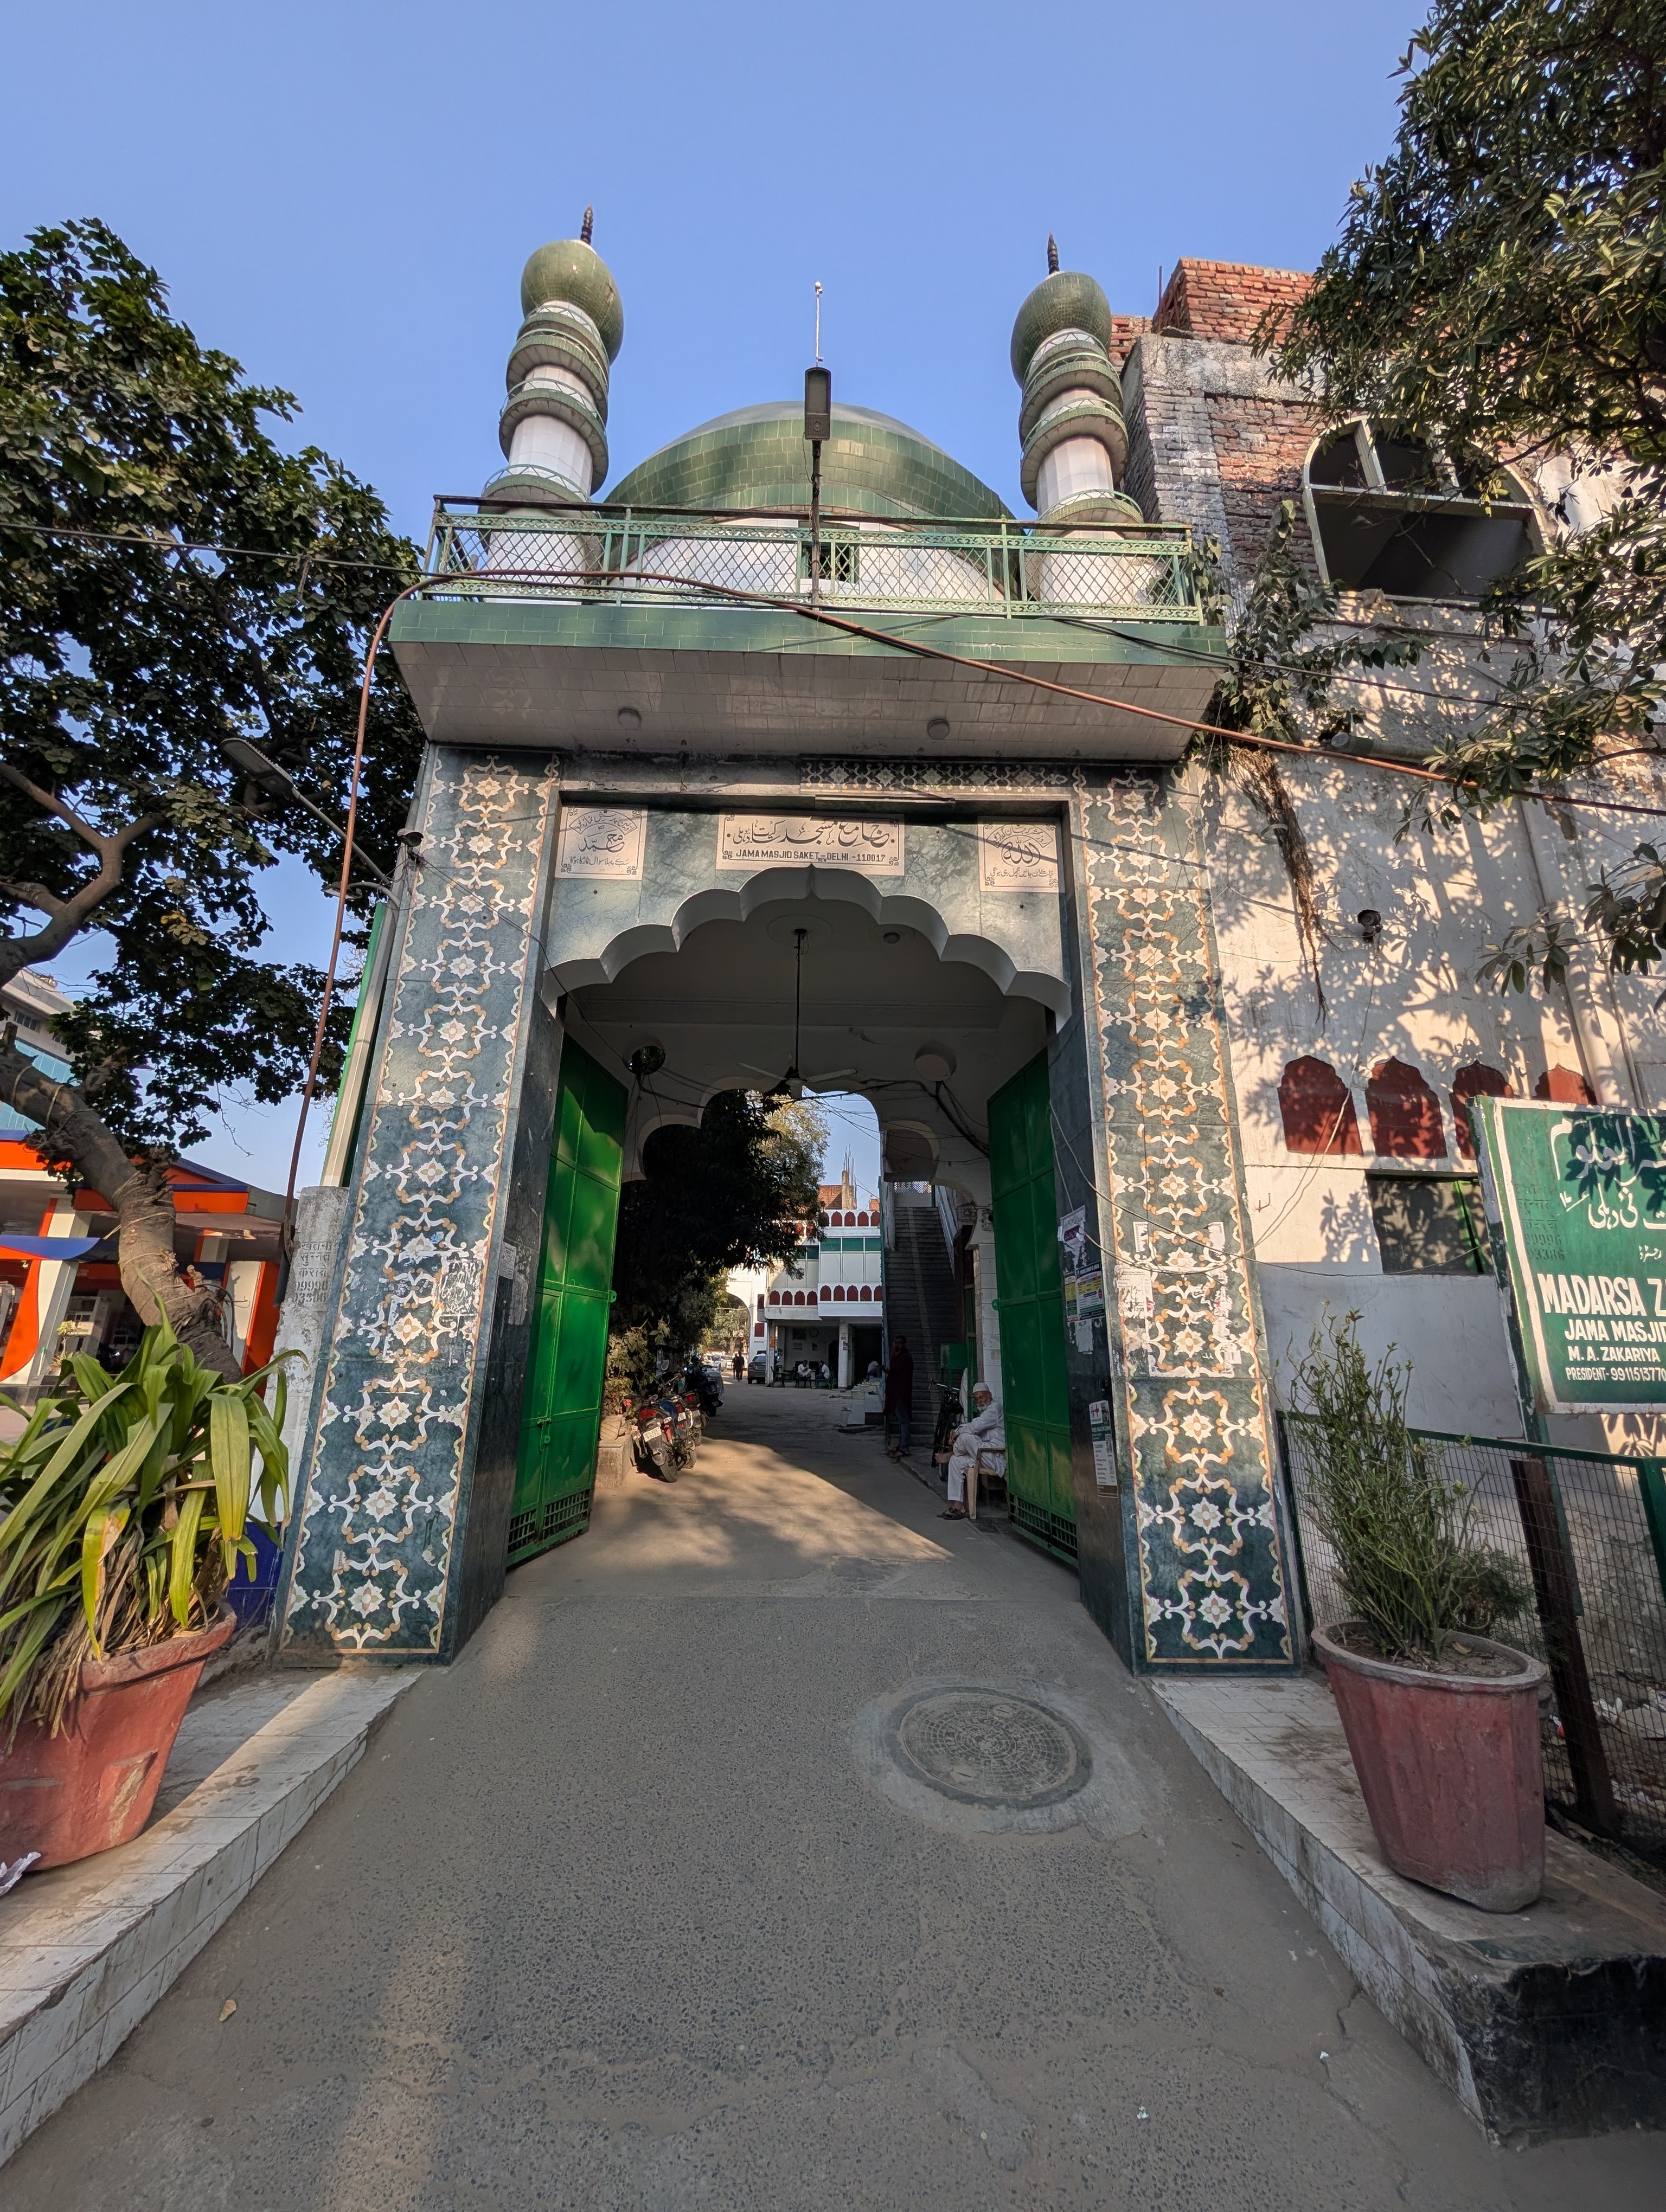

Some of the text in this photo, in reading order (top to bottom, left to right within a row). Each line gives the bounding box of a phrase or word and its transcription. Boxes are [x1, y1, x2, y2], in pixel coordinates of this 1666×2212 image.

[777, 819, 838, 845] مسجد
[838, 820, 890, 848] جامع
[736, 849, 760, 858] JAMA
[761, 850, 792, 859] MASJID
[793, 851, 819, 860] SAKET
[827, 852, 848, 861] DELHI
[1588, 1182, 1619, 1230] دہلی
[1537, 1274, 1647, 1316] MADARSA
[1564, 1319, 1610, 1341] JAMA
[1567, 1345, 1661, 1362] M. A. ZAKARIYA
